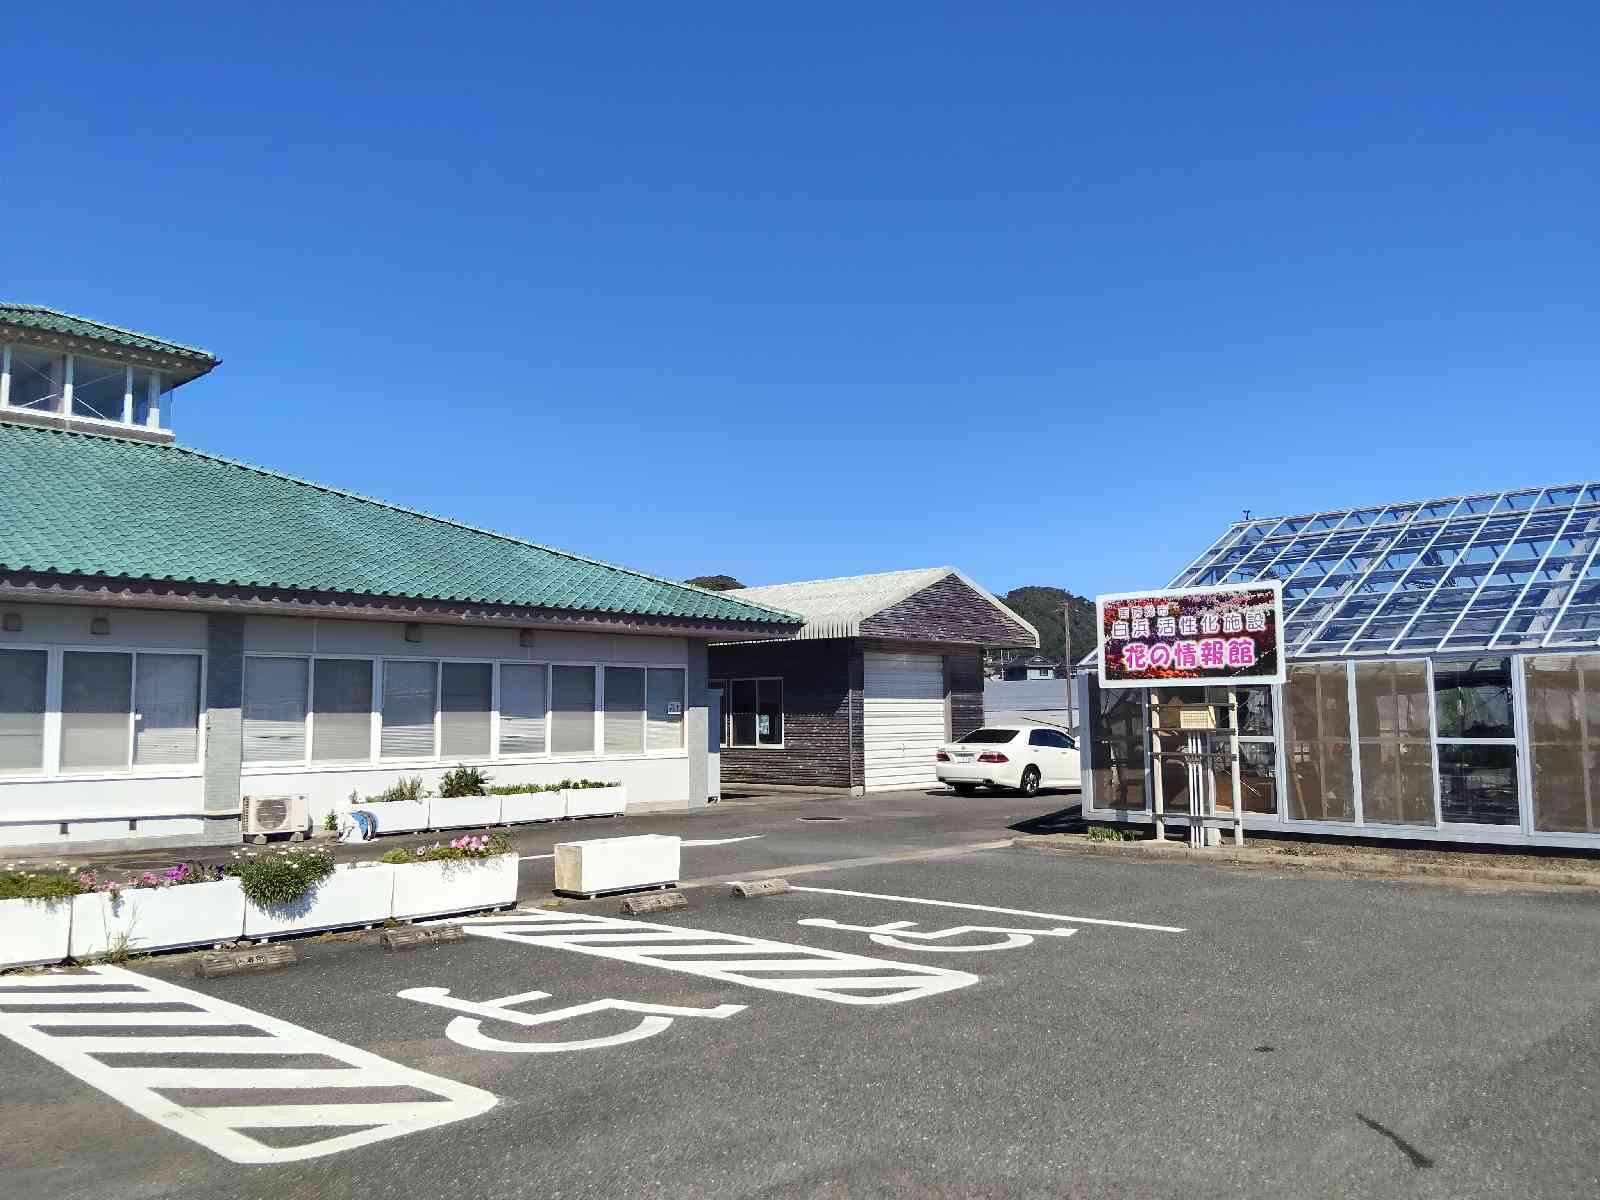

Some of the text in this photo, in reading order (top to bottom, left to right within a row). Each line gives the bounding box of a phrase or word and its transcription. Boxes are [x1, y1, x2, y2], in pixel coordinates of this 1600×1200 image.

[1113, 612, 1266, 638] 白浜活性化施設
[1124, 639, 1255, 668] 花の情報館
